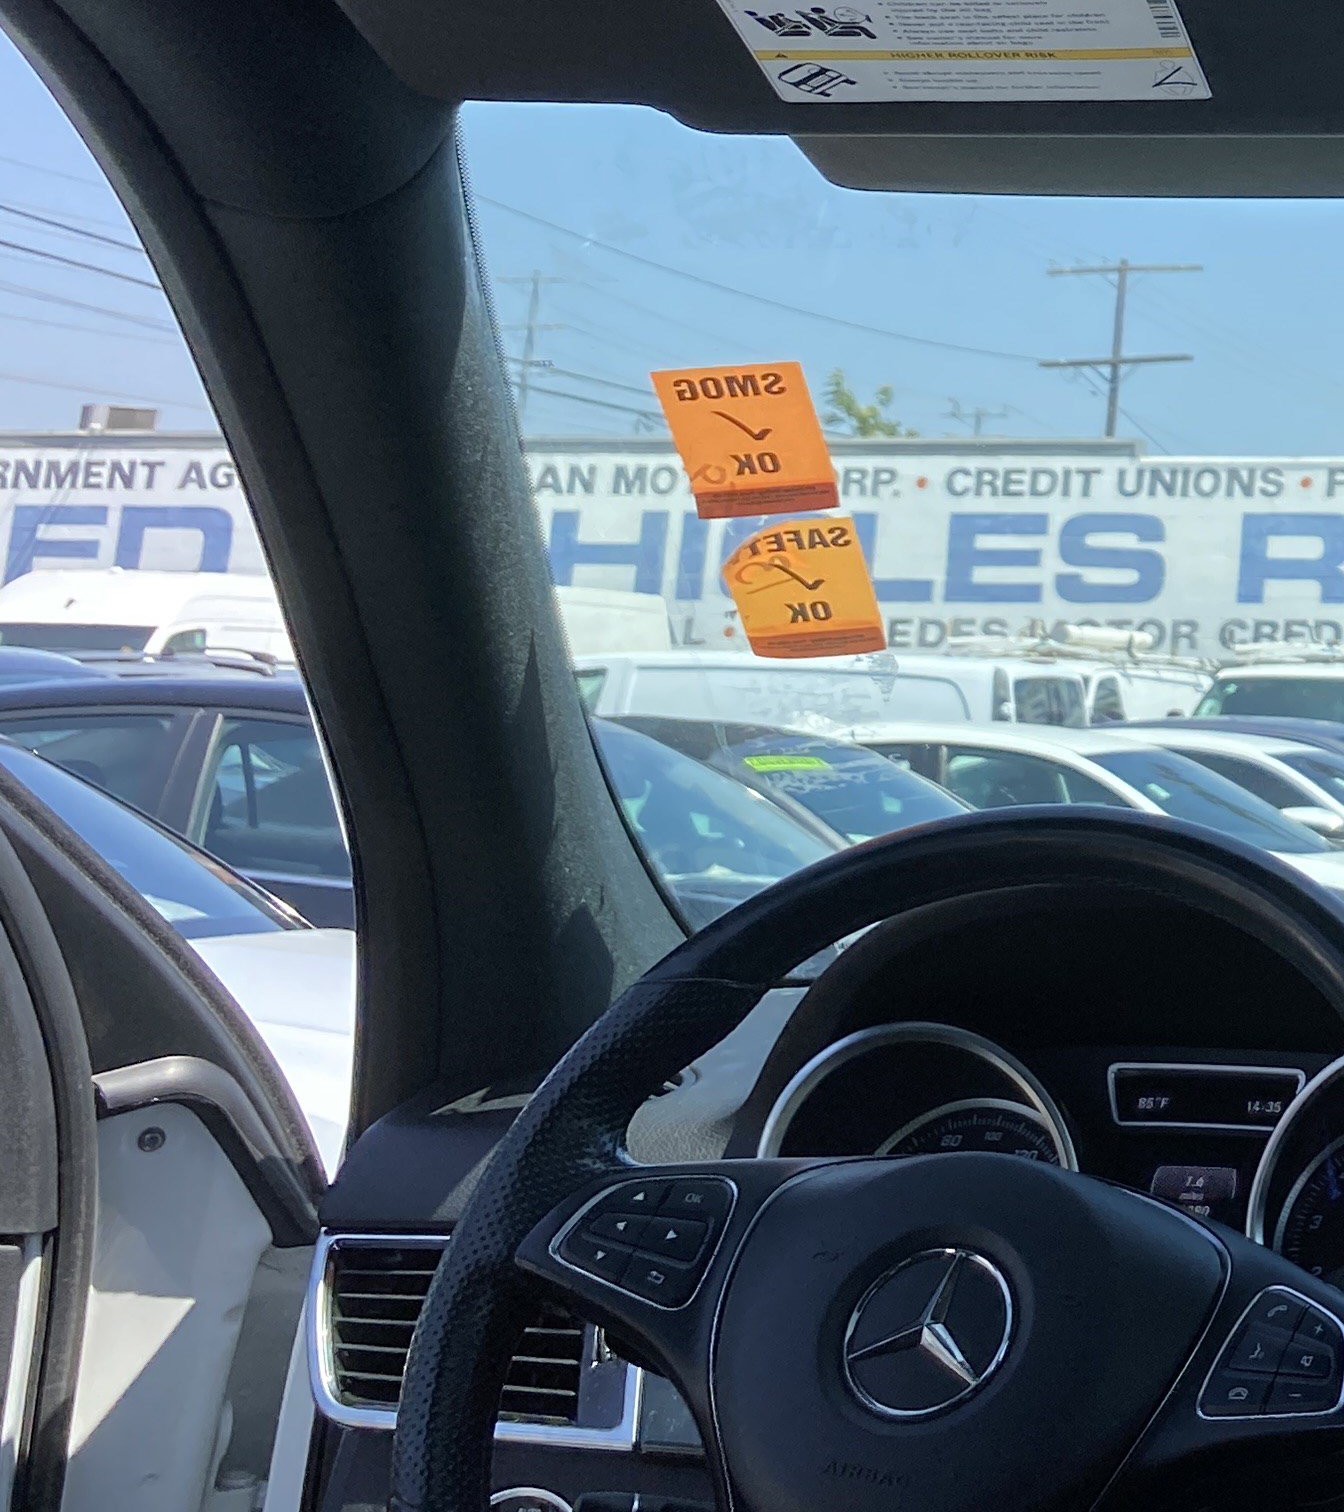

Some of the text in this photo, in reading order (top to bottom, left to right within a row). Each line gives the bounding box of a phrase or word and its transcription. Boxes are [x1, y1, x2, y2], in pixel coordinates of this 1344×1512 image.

[947, 51, 1021, 59] ROLLOVER
[1025, 50, 1058, 59] RISK
[536, 462, 598, 496] AN
[611, 463, 684, 496] MO
[842, 465, 902, 498] RP.
[945, 466, 1104, 498] CREDIT
[1116, 467, 1285, 499] UNIONS
[684, 1192, 704, 1204] OK
